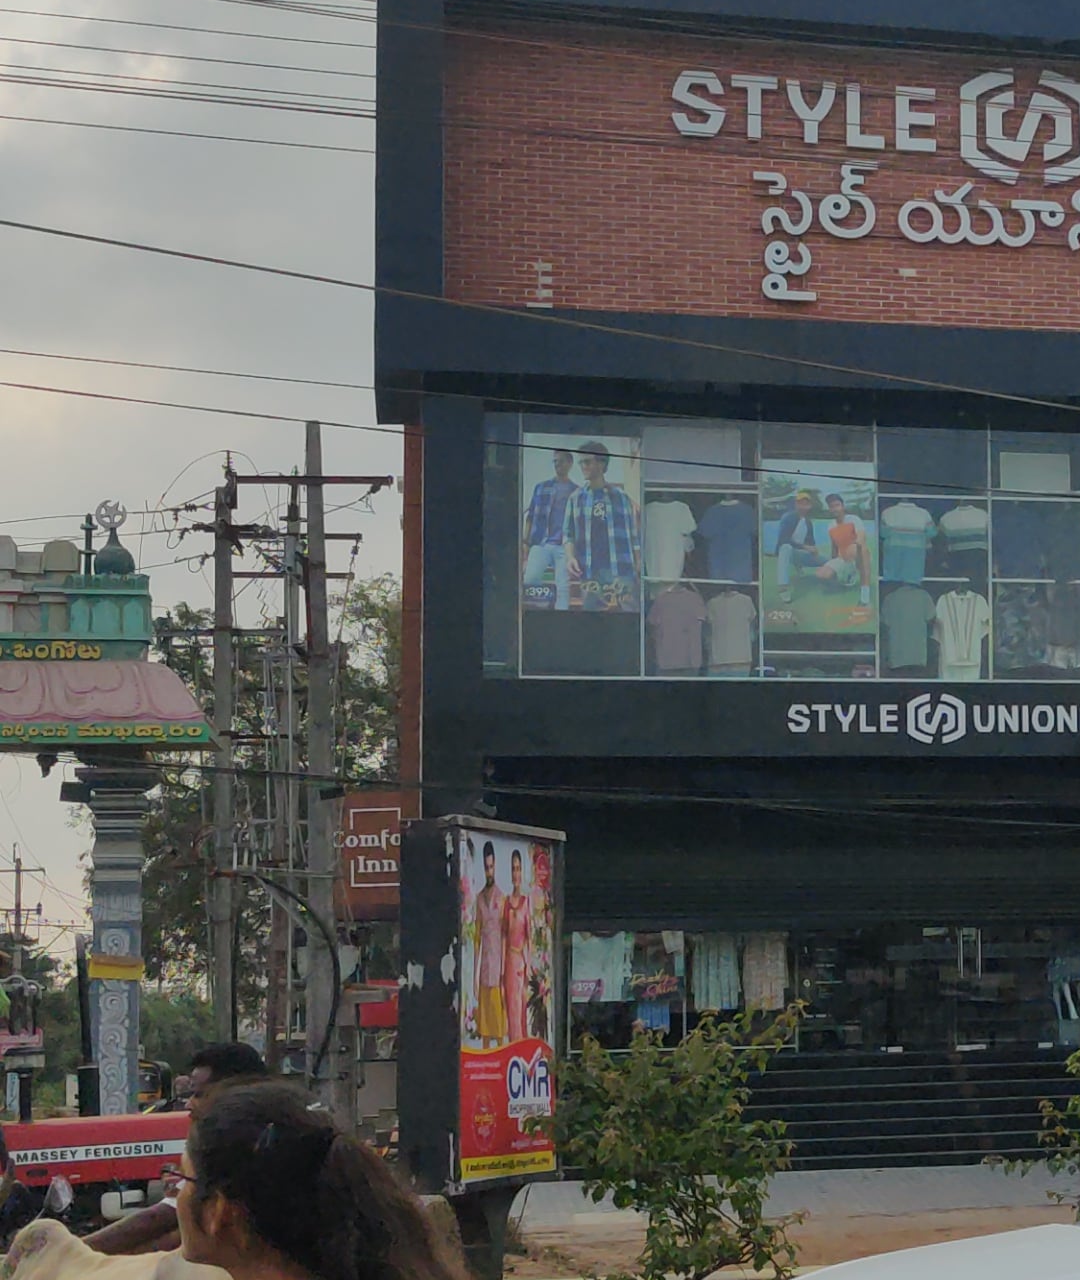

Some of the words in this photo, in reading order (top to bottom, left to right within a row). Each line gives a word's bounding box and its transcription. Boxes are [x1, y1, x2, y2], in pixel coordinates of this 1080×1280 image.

[671, 69, 938, 153] STYLE
[787, 704, 898, 734] STYLE
[973, 705, 1079, 734] UNION
[357, 855, 398, 873] Inn
[508, 1048, 550, 1100] CMR
[16, 1150, 77, 1163] MASSEY
[85, 1144, 164, 1158] FERGUSON
